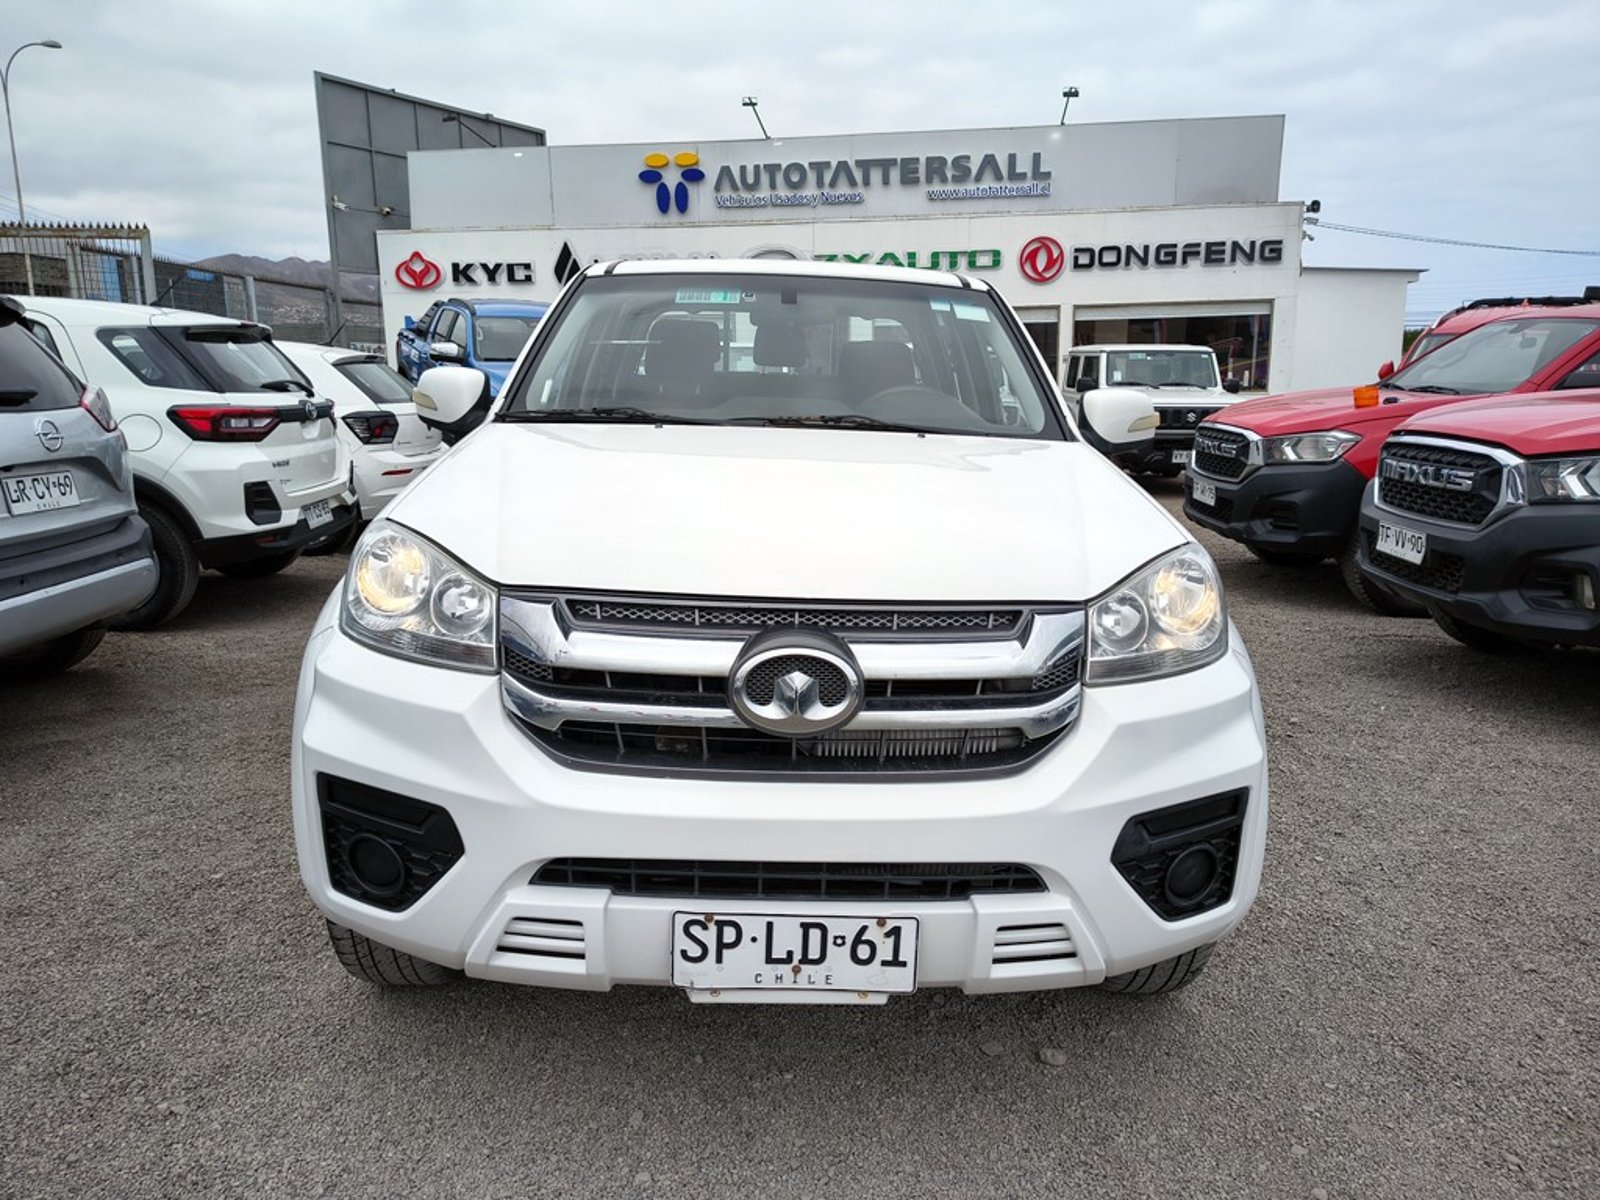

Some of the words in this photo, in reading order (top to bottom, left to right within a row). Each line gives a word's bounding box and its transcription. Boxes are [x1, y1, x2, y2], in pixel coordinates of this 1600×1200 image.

[714, 152, 1052, 192] AUTOTATTERSALL
[770, 192, 809, 206] Usados
[821, 191, 864, 204] Nuevos
[928, 182, 1051, 200] www.autotattersall.cl
[1072, 239, 1284, 270] DONGFENG
[451, 261, 534, 283] KYC
[755, 973, 833, 985] CHILE
